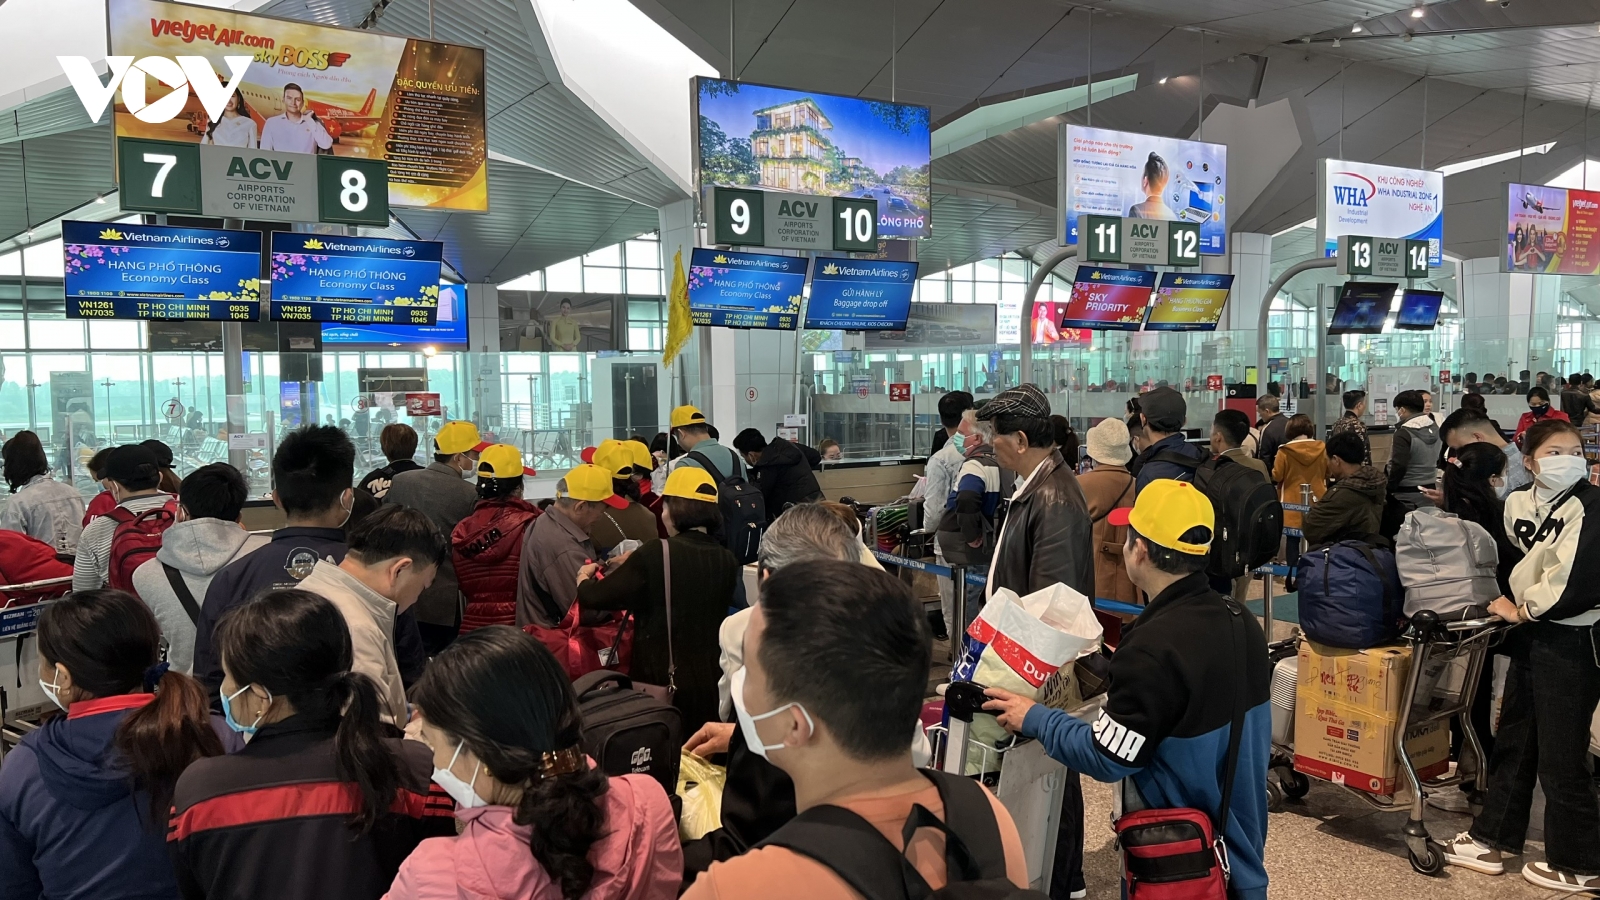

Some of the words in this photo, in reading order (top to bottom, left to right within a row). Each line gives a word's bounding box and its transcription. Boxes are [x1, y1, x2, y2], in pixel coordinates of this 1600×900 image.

[226, 157, 293, 181] ACV
[142, 153, 178, 198] 7
[1377, 175, 1389, 184] KHU
[1389, 176, 1405, 186] CÔNG
[237, 184, 285, 195] AIRPORTS
[339, 169, 369, 212] 8
[1377, 187, 1390, 196] WHA
[1391, 188, 1418, 200] INDUSTRIAL
[1418, 191, 1432, 200] ZONE
[226, 192, 295, 205] CORPORATION
[1333, 185, 1368, 207] WHA
[233, 202, 246, 211] OF
[248, 203, 290, 213] VIETNAM
[777, 200, 819, 218] ACV
[1347, 208, 1368, 216] Industrial
[1423, 203, 1432, 212] AN
[729, 198, 750, 234] 9
[1338, 215, 1368, 225] Development
[784, 221, 813, 229] AIRPORTS
[839, 207, 873, 243] 10
[777, 228, 820, 237] CORPORATION
[1130, 223, 1159, 239] ACV
[790, 236, 816, 244] VIETNAM
[1095, 223, 1116, 254] 11
[1173, 229, 1197, 259] 12
[1378, 242, 1399, 254] ACV
[1352, 241, 1371, 268] 13
[1409, 245, 1427, 271] 14
[108, 260, 146, 272] HẠNG
[178, 263, 222, 273] THÔNG
[122, 272, 177, 284] Economy
[180, 275, 209, 285] Class
[309, 268, 341, 280] HẠNG
[369, 270, 407, 281] THÔNG
[319, 280, 367, 291] Economy
[369, 282, 395, 291] Class
[755, 281, 781, 291] THÔNG
[720, 289, 752, 299] Economy
[1088, 292, 1108, 302] SKY
[79, 301, 114, 309] VN1261
[137, 302, 149, 310] TP
[168, 303, 184, 311] CHI
[834, 298, 861, 309] Baggage
[863, 299, 878, 309] drop
[878, 300, 888, 308] off
[1085, 302, 1129, 312] PRIORITY
[79, 309, 114, 317] VN7035
[137, 310, 149, 318] TP
[186, 311, 210, 319] MINH
[343, 307, 355, 315] HO
[373, 308, 394, 316] MINH
[343, 314, 355, 322] HO
[749, 390, 755, 399] 9
[167, 404, 176, 415] 7
[357, 399, 365, 409] 8
[880, 551, 904, 564] CORPORATION
[909, 560, 926, 570] VIETNAM
[3, 611, 25, 620] BIZMAN
[631, 746, 650, 766] FPT
